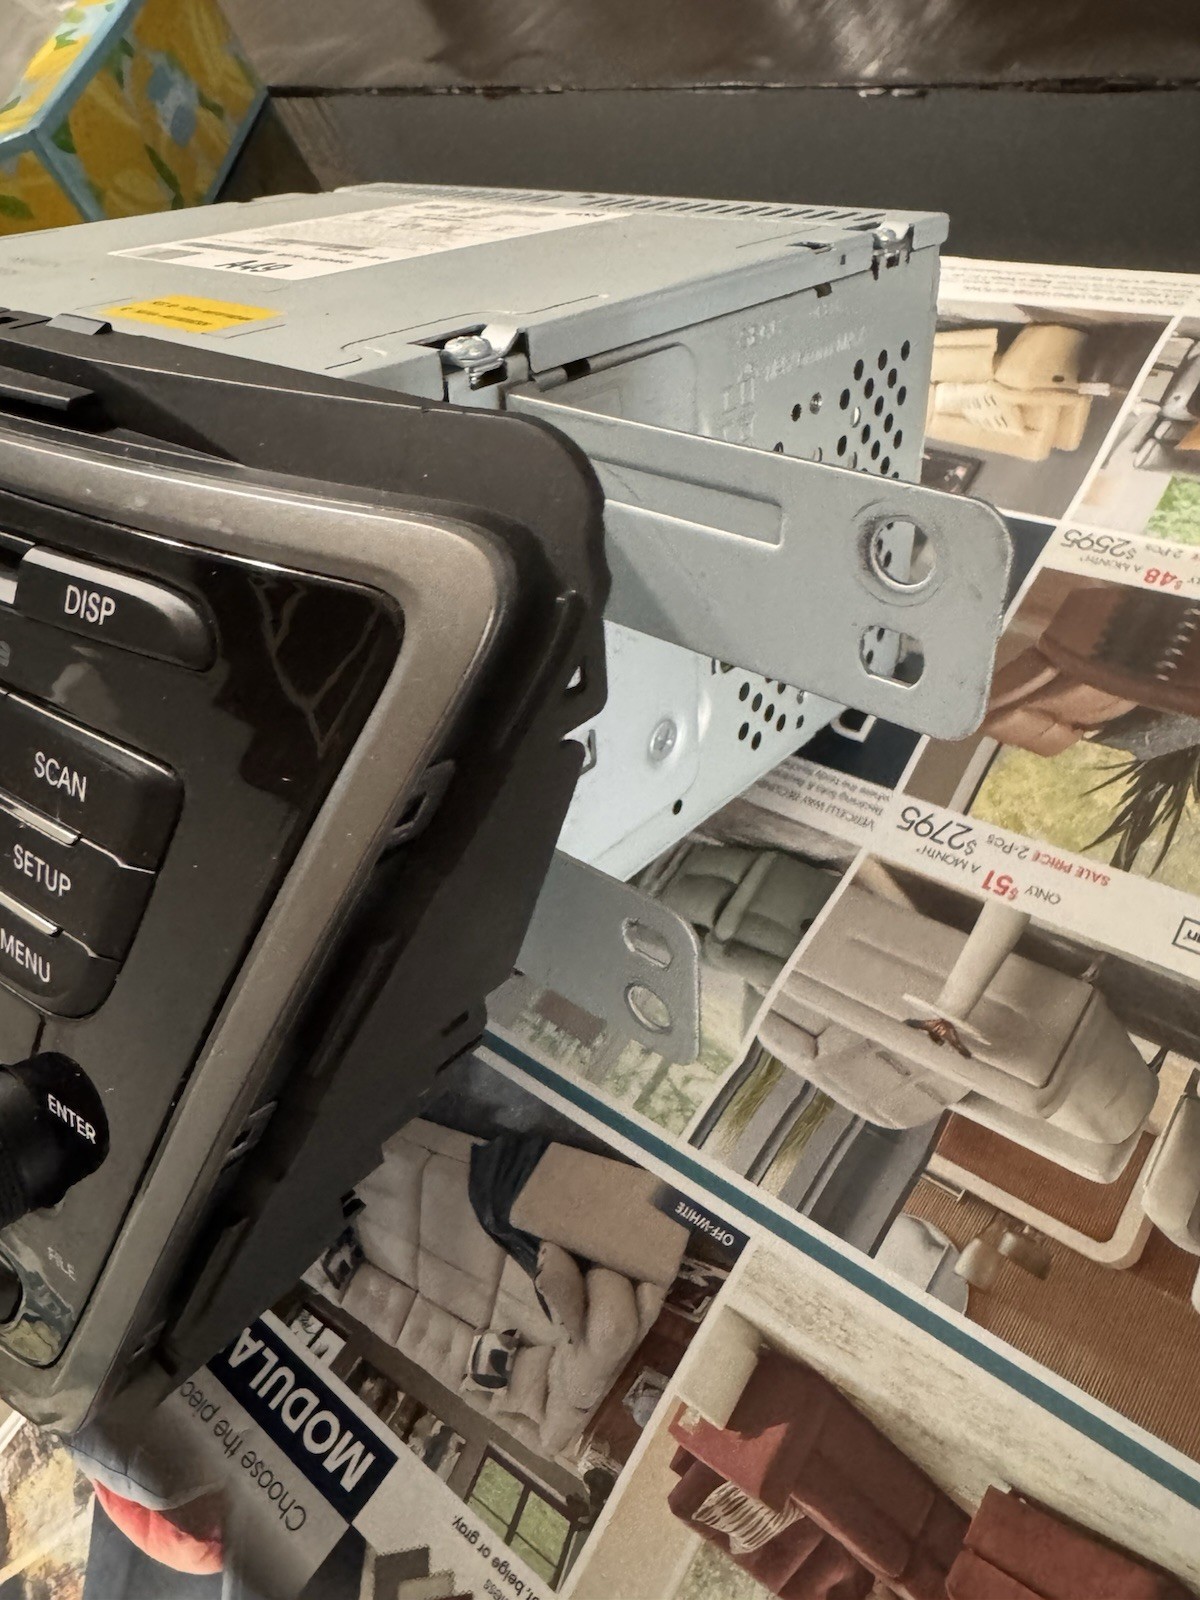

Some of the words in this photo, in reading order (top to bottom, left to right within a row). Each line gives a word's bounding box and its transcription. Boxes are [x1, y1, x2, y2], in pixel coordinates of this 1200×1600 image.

[1060, 529, 1138, 560] $2595
[1143, 567, 1183, 591] $48
[63, 584, 116, 626] DISP
[33, 750, 87, 803] SCAN
[896, 805, 978, 857] $2795
[13, 843, 72, 898] SETUP
[1031, 849, 1074, 875] PRICE
[1074, 865, 1111, 887] SALE
[980, 869, 1020, 902] $51
[1023, 884, 1062, 905] ONLY
[0, 927, 51, 983] MENU
[47, 1092, 97, 1145] ENTER
[674, 1201, 735, 1247] OFF-WHITE
[227, 1326, 377, 1493] MODULA
[213, 1417, 245, 1457] the
[240, 1448, 308, 1532] Choose
[451, 1515, 481, 1545] gray.
[477, 1543, 492, 1559] or
[491, 1556, 526, 1596] beige
